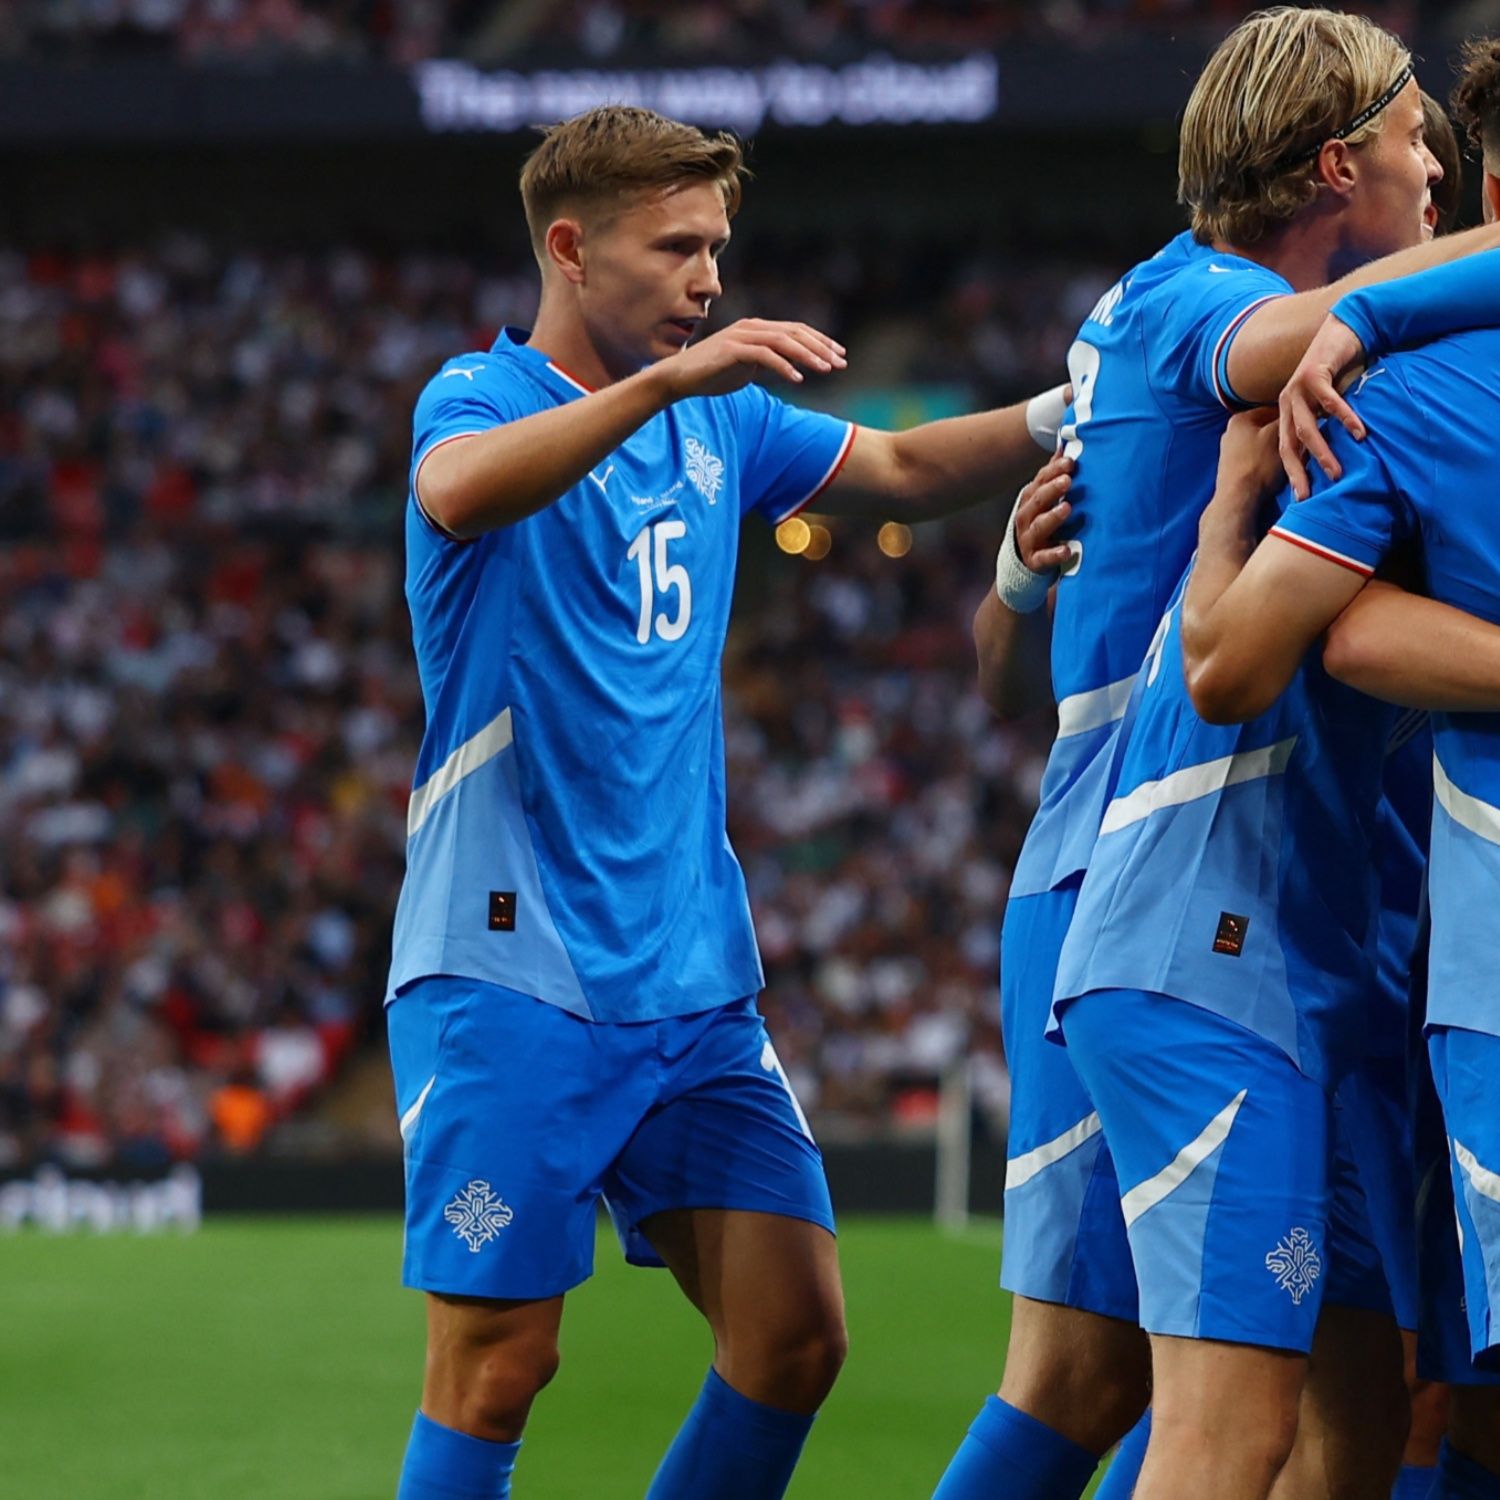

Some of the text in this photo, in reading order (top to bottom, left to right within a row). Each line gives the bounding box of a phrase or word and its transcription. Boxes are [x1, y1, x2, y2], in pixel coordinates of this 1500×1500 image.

[420, 60, 526, 131] The
[656, 68, 763, 138] way
[767, 58, 832, 126] to
[839, 52, 997, 124] cloud
[626, 520, 692, 645] 15
